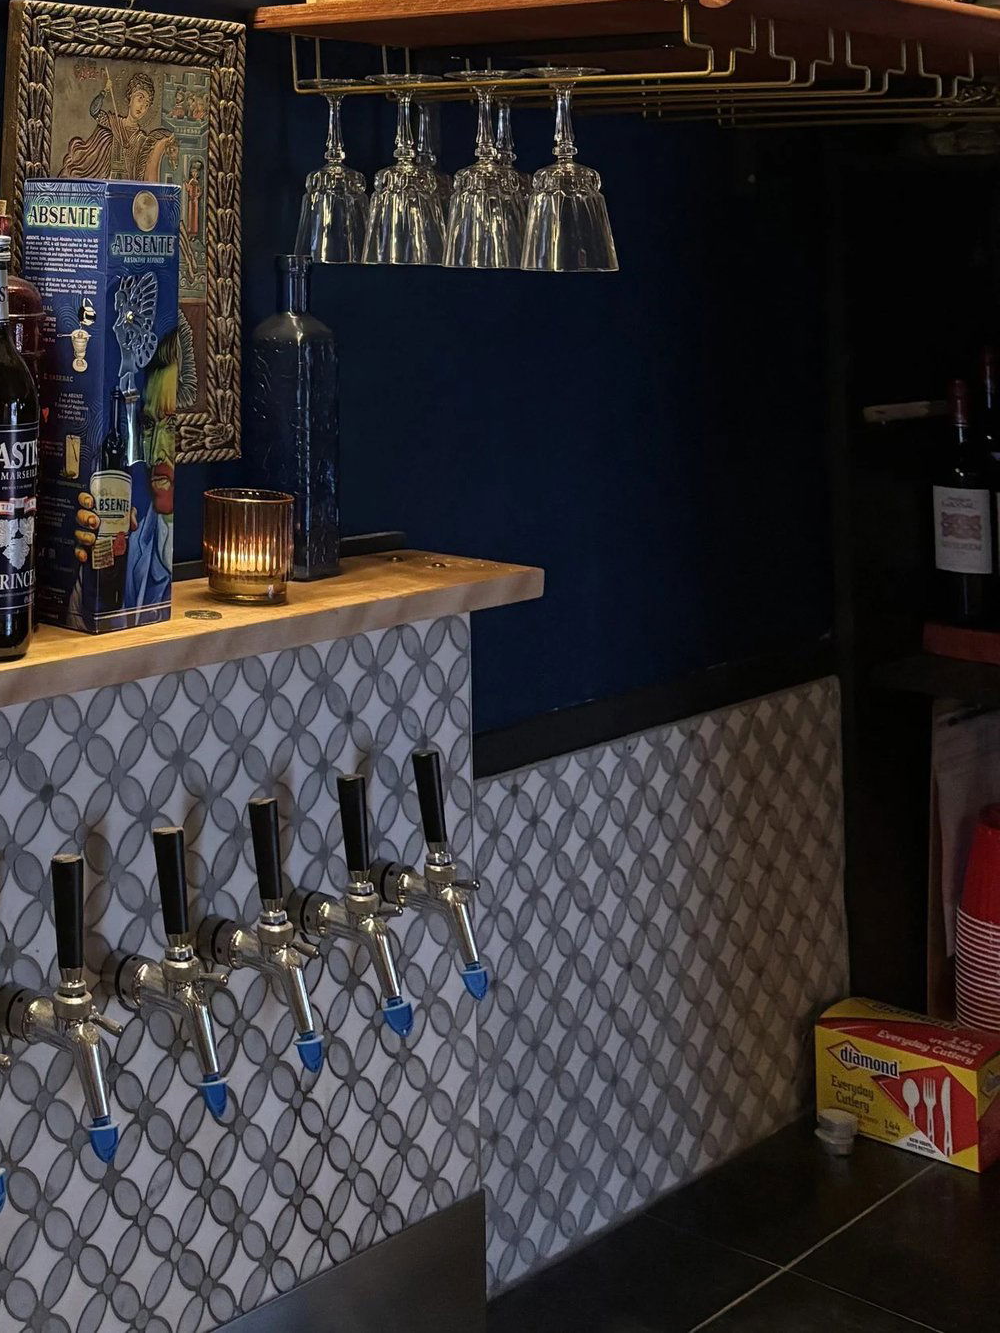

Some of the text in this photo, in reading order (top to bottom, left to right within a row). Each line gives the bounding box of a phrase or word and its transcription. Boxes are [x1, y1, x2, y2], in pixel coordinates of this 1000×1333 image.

[27, 205, 99, 227] ABSENTE
[112, 235, 174, 255] ABSENTE
[840, 1046, 899, 1077] diamond
[831, 1075, 875, 1101] Everyday
[836, 1091, 870, 1114] Cutlery
